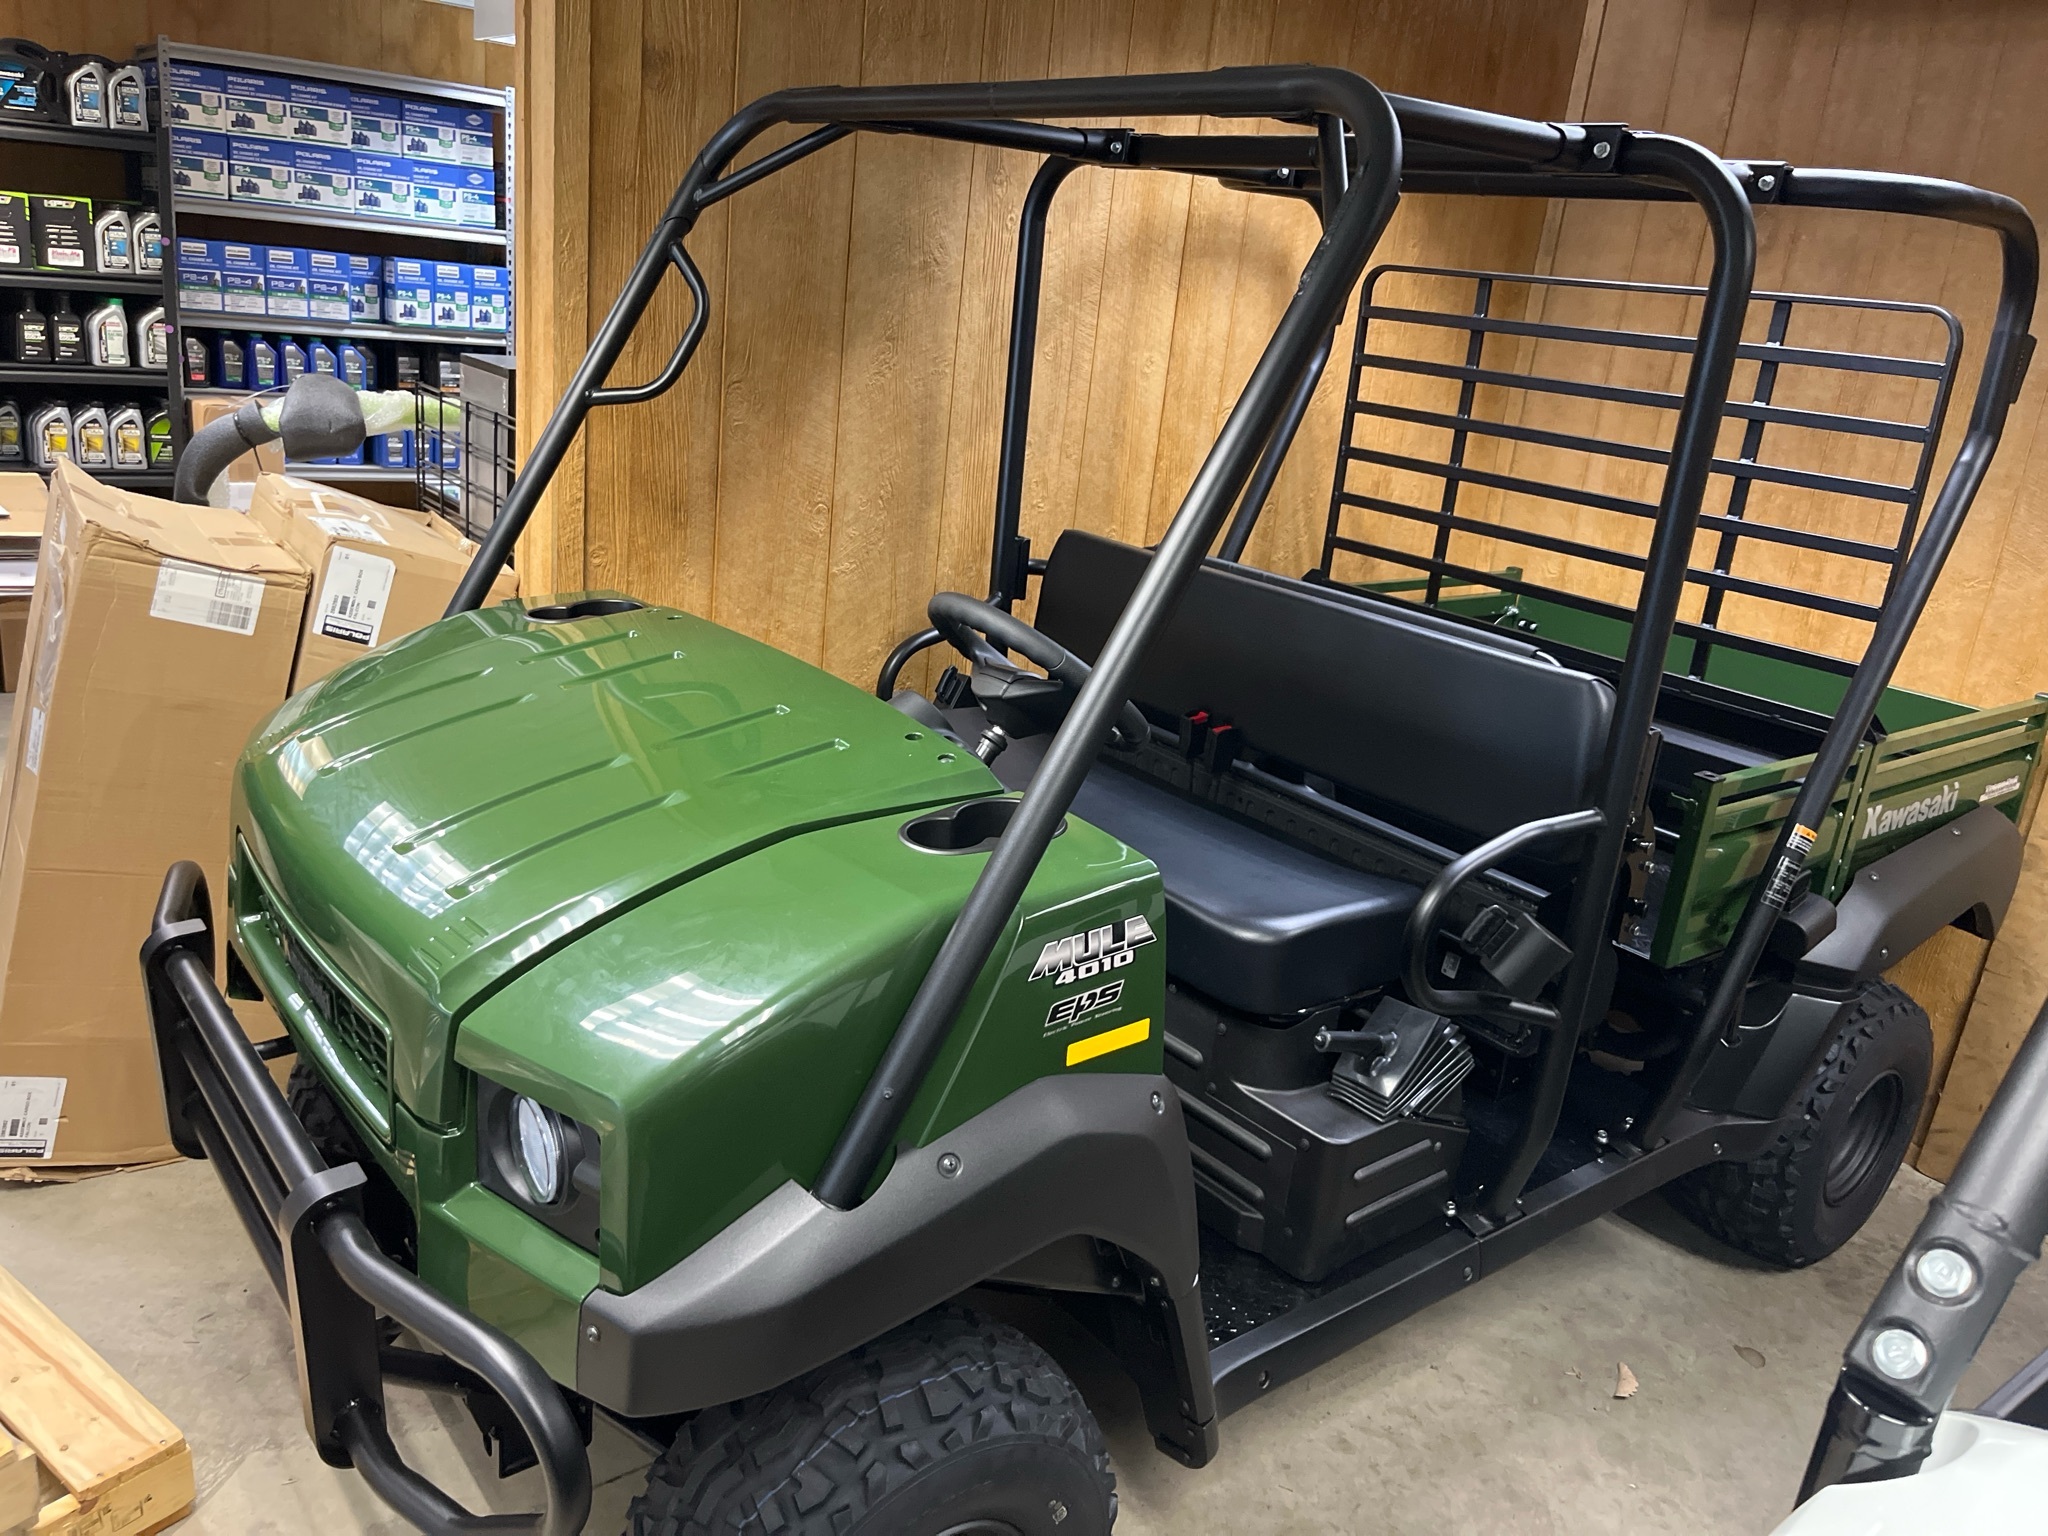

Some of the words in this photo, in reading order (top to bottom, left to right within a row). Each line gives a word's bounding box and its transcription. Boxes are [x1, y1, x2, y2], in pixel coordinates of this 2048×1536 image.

[227, 76, 265, 86] POLARIS
[291, 84, 327, 95] POLARIS
[351, 97, 379, 105] OLARIS
[405, 104, 438, 114] POLARIS
[232, 141, 270, 152] POLARIS
[295, 150, 331, 160] POLARIS
[356, 158, 391, 168] POLARIS
[325, 625, 370, 641] POLARIS
[1862, 782, 1960, 840] Kawasaki
[1028, 914, 1157, 982] MULE
[1055, 949, 1134, 985] 4010
[1044, 979, 1125, 1027] EPS
[1043, 1025, 1068, 1038] Electric
[1071, 1017, 1092, 1027] Power
[1095, 1006, 1122, 1018] Steering
